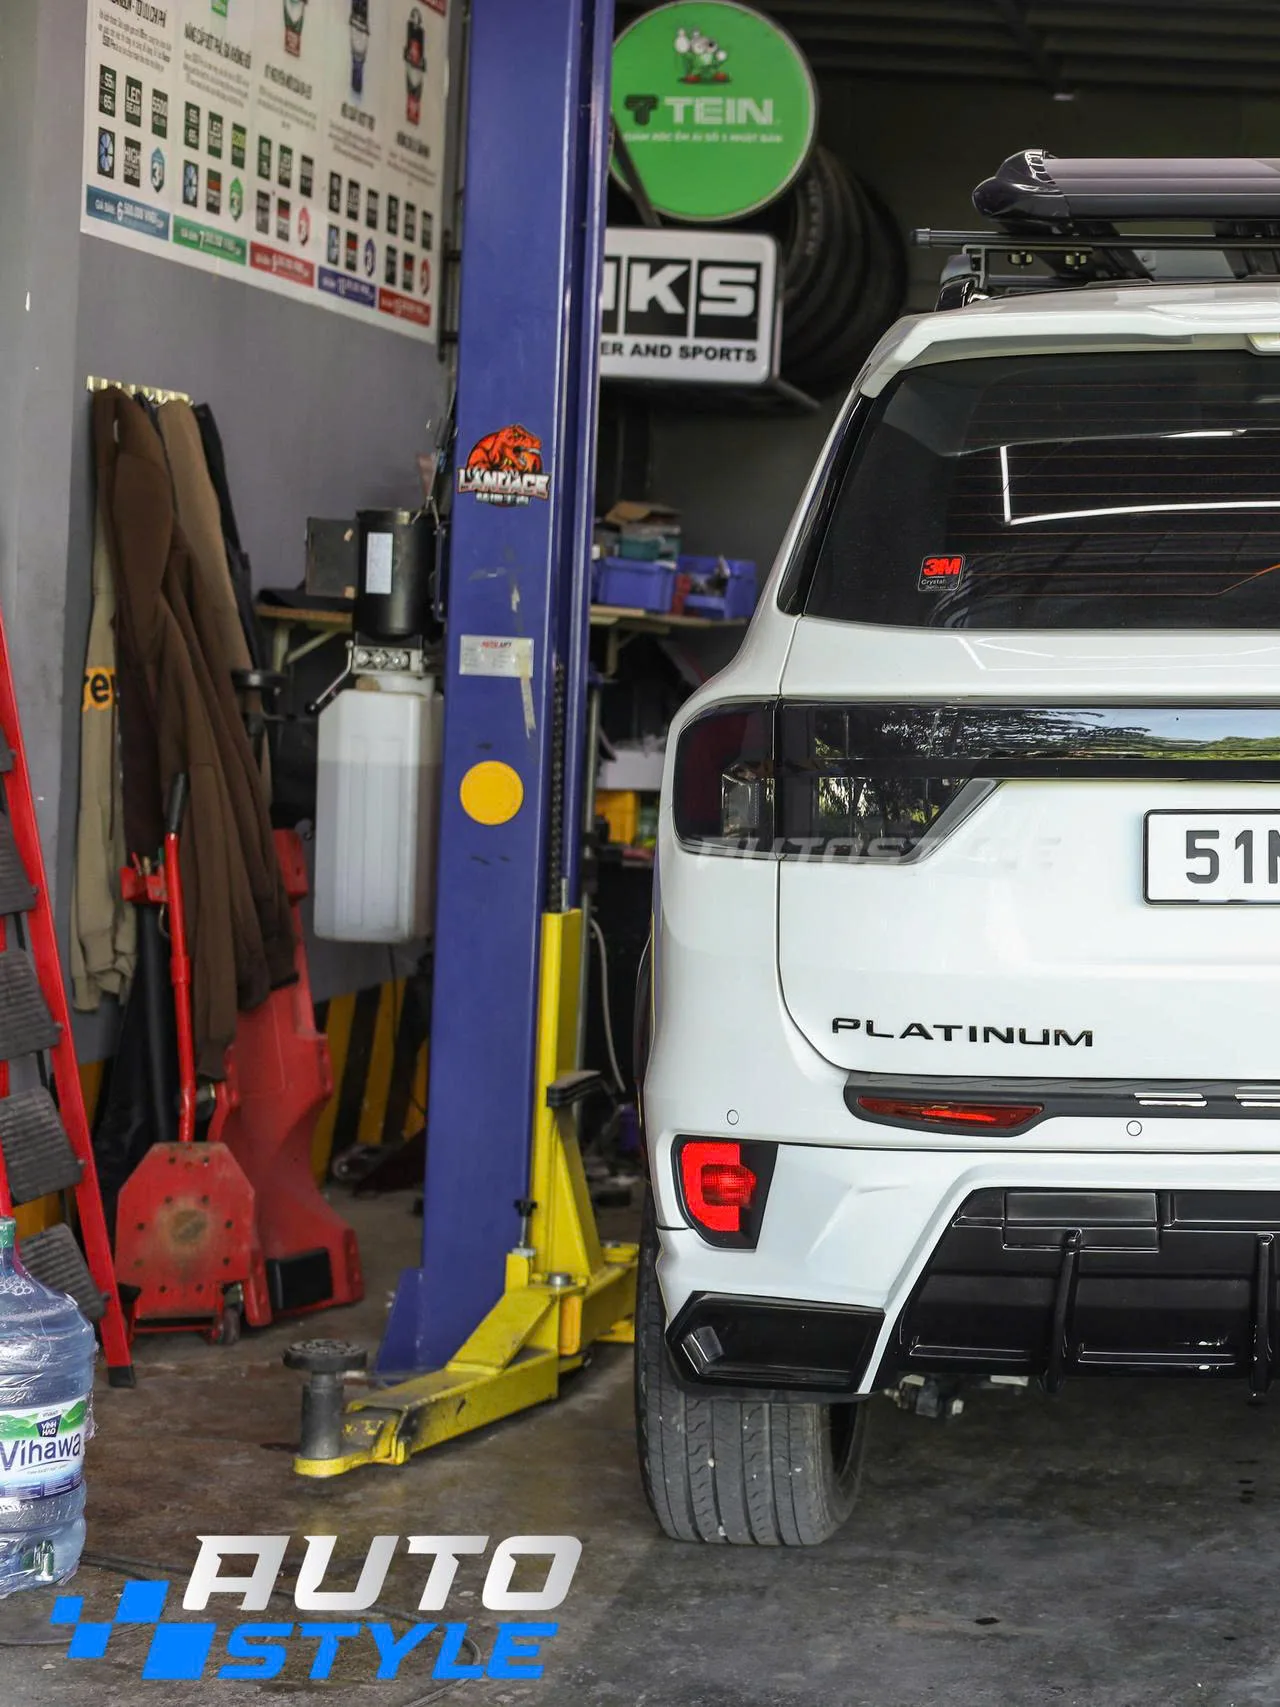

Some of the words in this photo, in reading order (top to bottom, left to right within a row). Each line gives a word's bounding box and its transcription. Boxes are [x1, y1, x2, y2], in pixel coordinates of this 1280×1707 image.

[664, 96, 774, 125] TEIN
[602, 262, 757, 318] KS
[630, 344, 672, 359] AND
[678, 345, 757, 363] SPORTS
[923, 557, 962, 576] 3M
[832, 1017, 1094, 1048] PLATINUM
[0, 1433, 81, 1472] Vihawa
